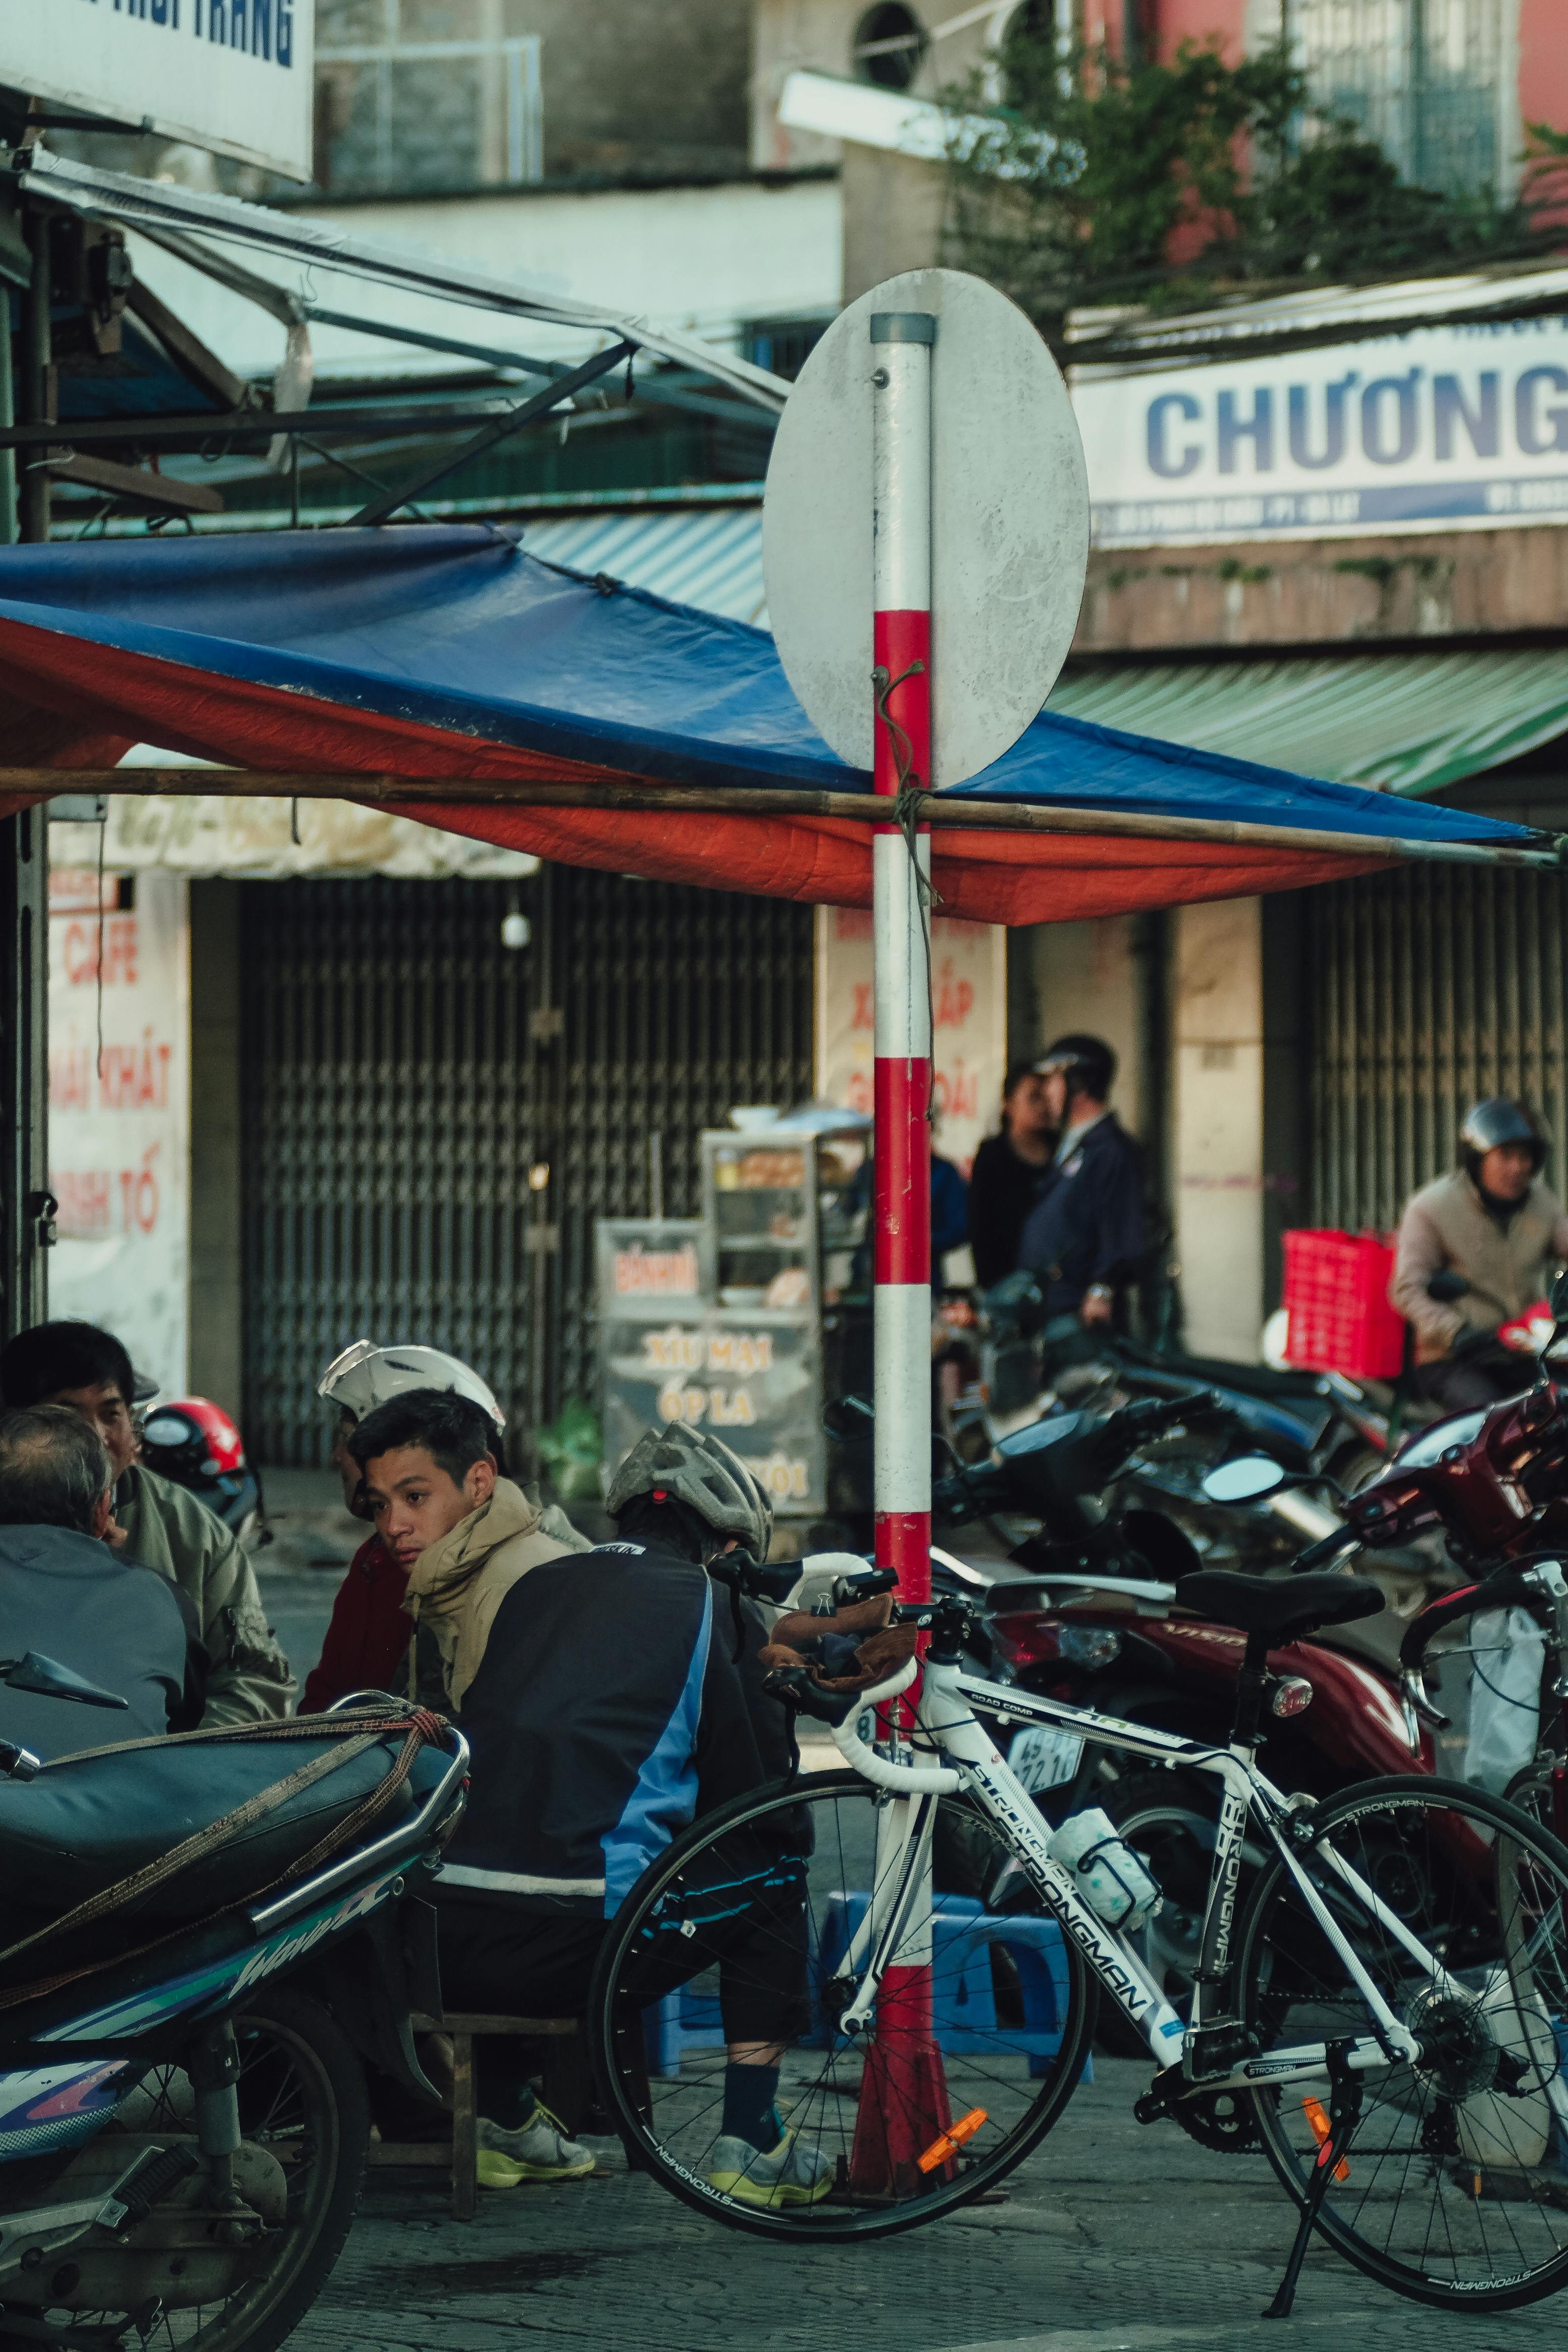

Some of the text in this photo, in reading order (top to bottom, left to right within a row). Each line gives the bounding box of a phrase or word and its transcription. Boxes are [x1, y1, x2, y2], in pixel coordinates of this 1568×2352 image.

[1144, 363, 1568, 480] CHƯƠNG
[971, 1693, 1033, 1716] ROAD COMP
[1345, 1800, 1425, 1821] STRONGMAN
[997, 1816, 1147, 2010] STRONGMAN
[1249, 2065, 1296, 2075] STRONGMAN
[655, 2146, 734, 2206] STRONGMAN
[1450, 2270, 1532, 2290] STRONGMAN
